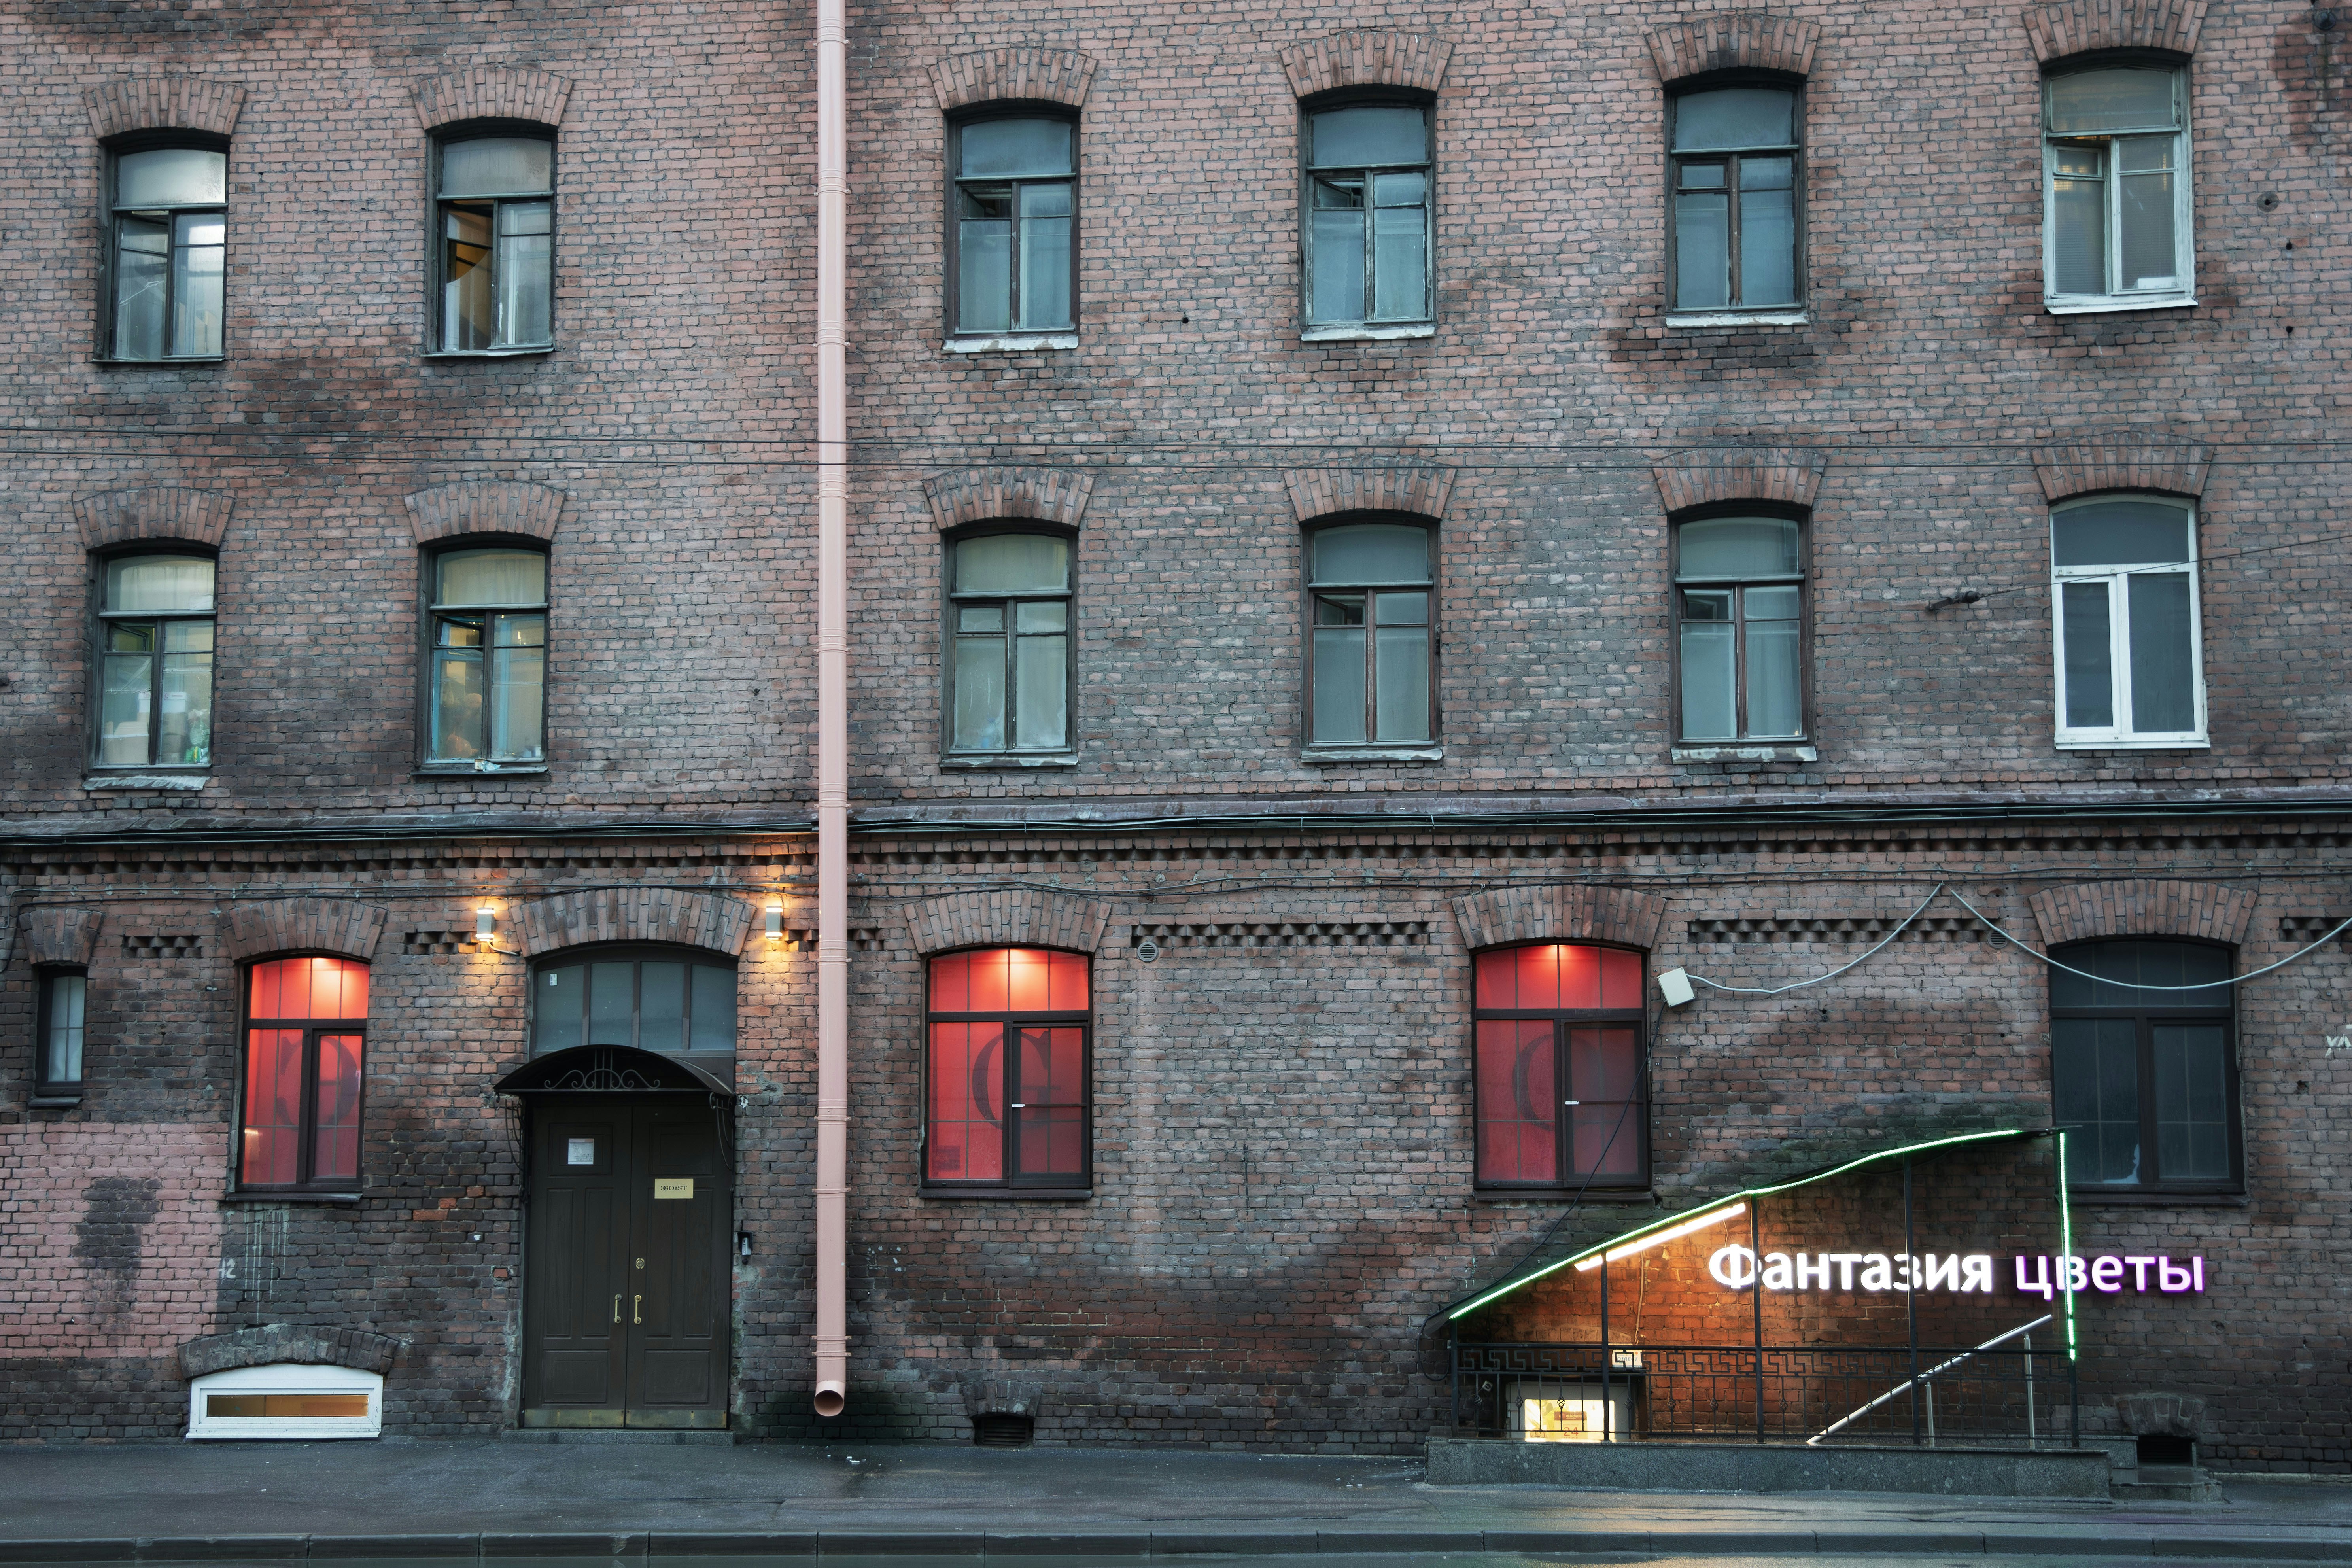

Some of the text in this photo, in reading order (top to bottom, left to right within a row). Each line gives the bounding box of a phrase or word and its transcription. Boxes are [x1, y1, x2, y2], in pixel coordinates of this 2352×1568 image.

[1709, 1244, 2203, 1300] Фантазия цветы
[1564, 1427, 1579, 1436] 24
